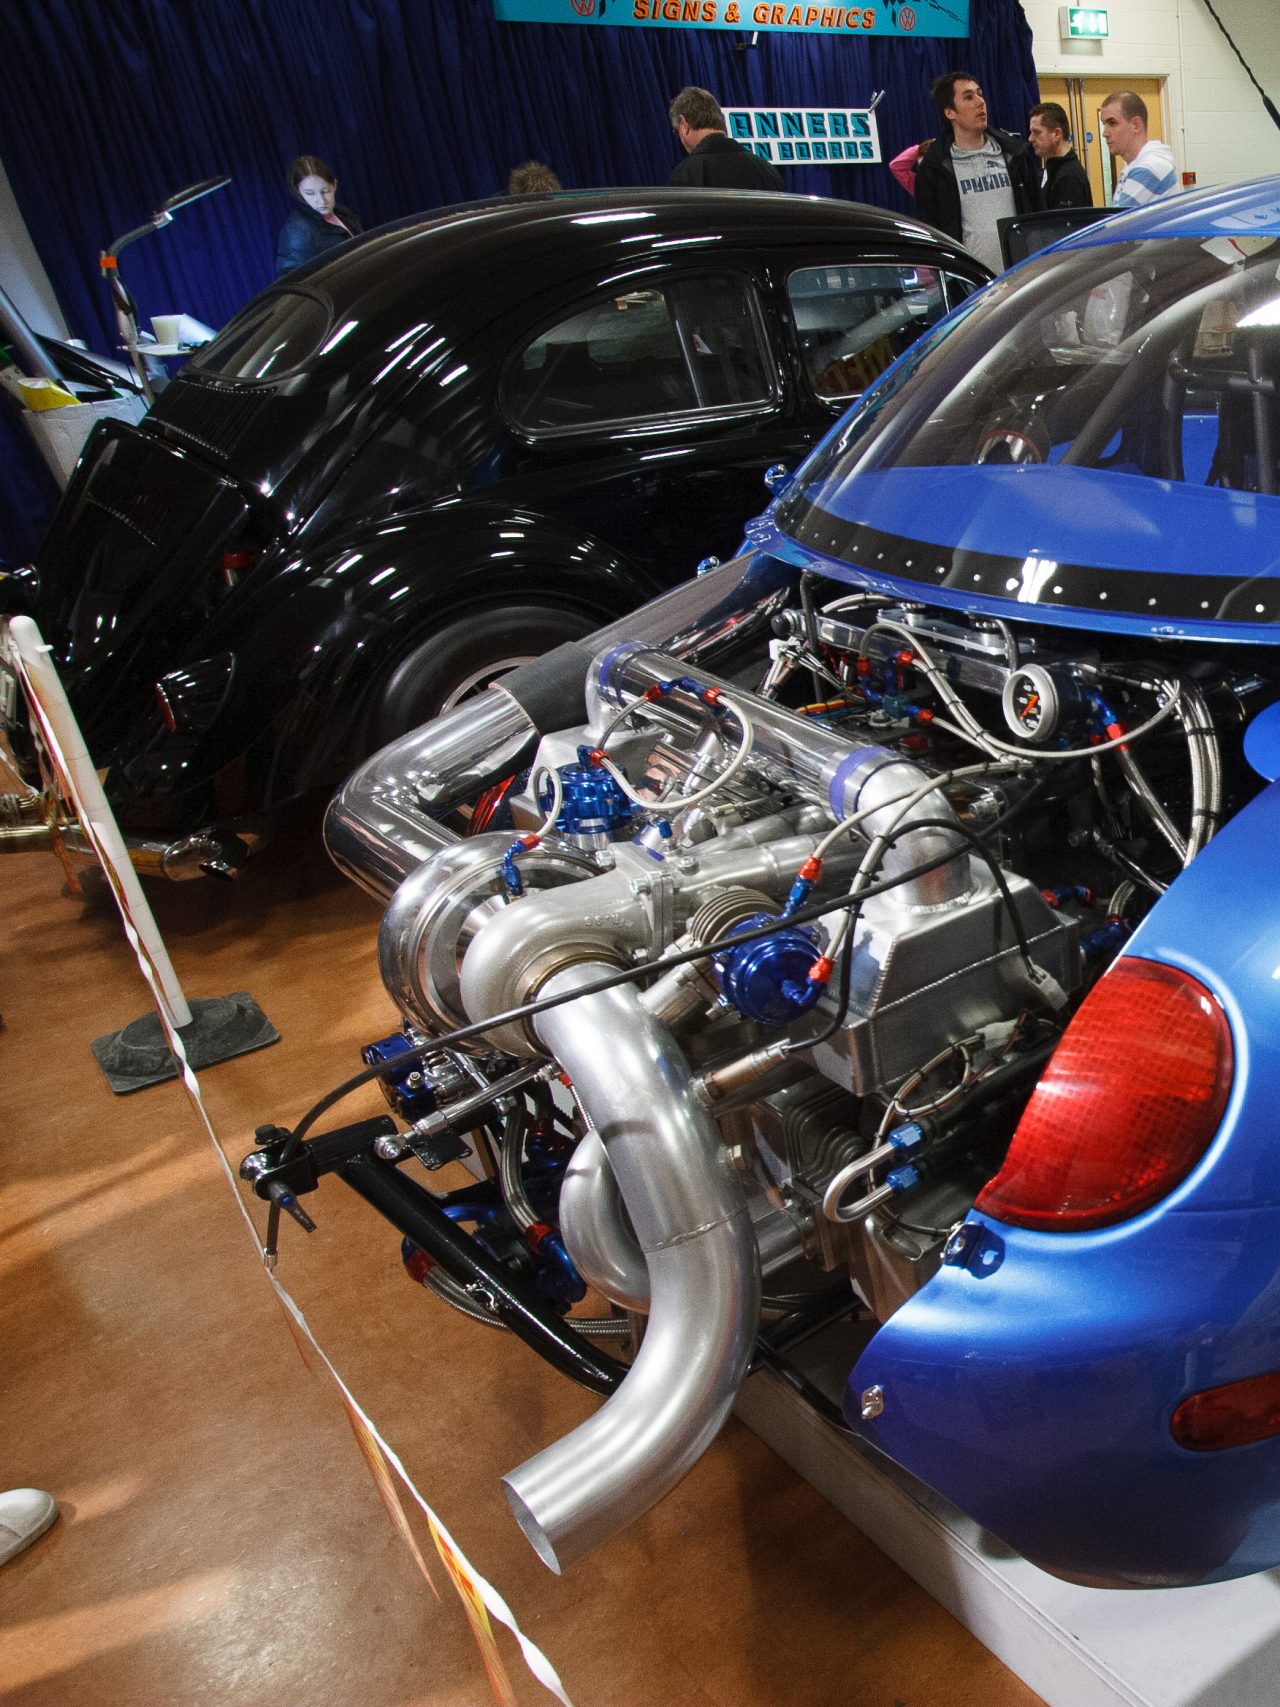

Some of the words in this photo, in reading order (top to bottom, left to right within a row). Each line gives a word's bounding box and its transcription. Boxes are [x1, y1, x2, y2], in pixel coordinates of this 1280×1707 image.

[633, 0, 717, 22] SIGNS
[725, 1, 740, 24] &
[753, 3, 876, 30] GRAPHICS
[729, 111, 872, 139] ANNERS
[777, 141, 875, 160] BOARDS
[960, 172, 1010, 195] PUMA
